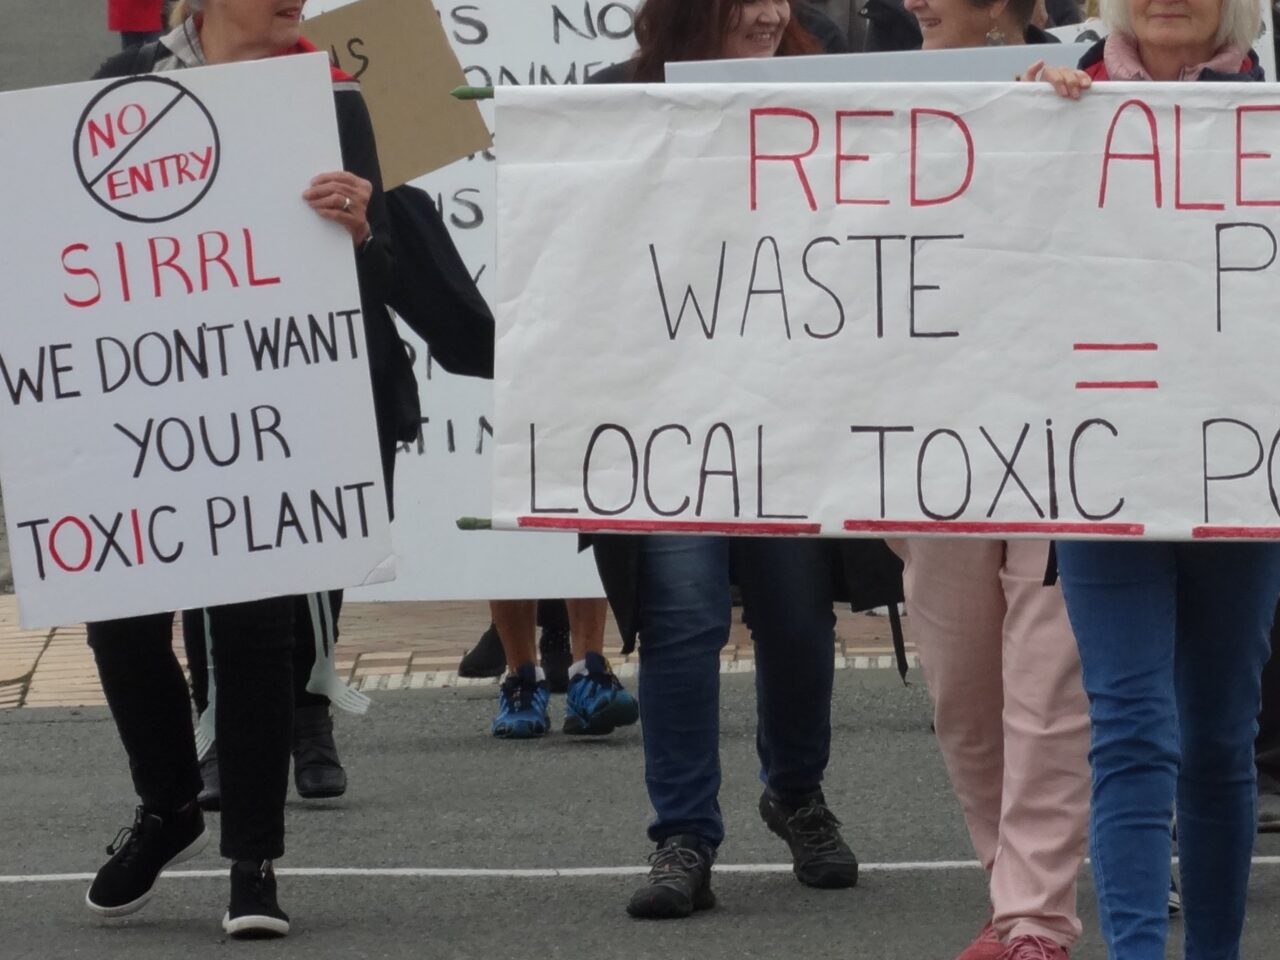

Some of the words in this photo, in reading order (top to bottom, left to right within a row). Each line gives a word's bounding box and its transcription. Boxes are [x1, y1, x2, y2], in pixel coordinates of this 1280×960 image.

[87, 102, 148, 157] NO
[106, 145, 213, 201] ENTRY
[748, 106, 976, 211] RED
[61, 227, 281, 309] SIRRL
[648, 233, 966, 341] WASTE
[0, 342, 81, 405] WE
[243, 309, 362, 372] WANT
[113, 404, 292, 479] YOUR
[529, 421, 810, 519] LOCAL
[17, 504, 184, 581] TOXIC
[205, 480, 376, 557] PLANT
